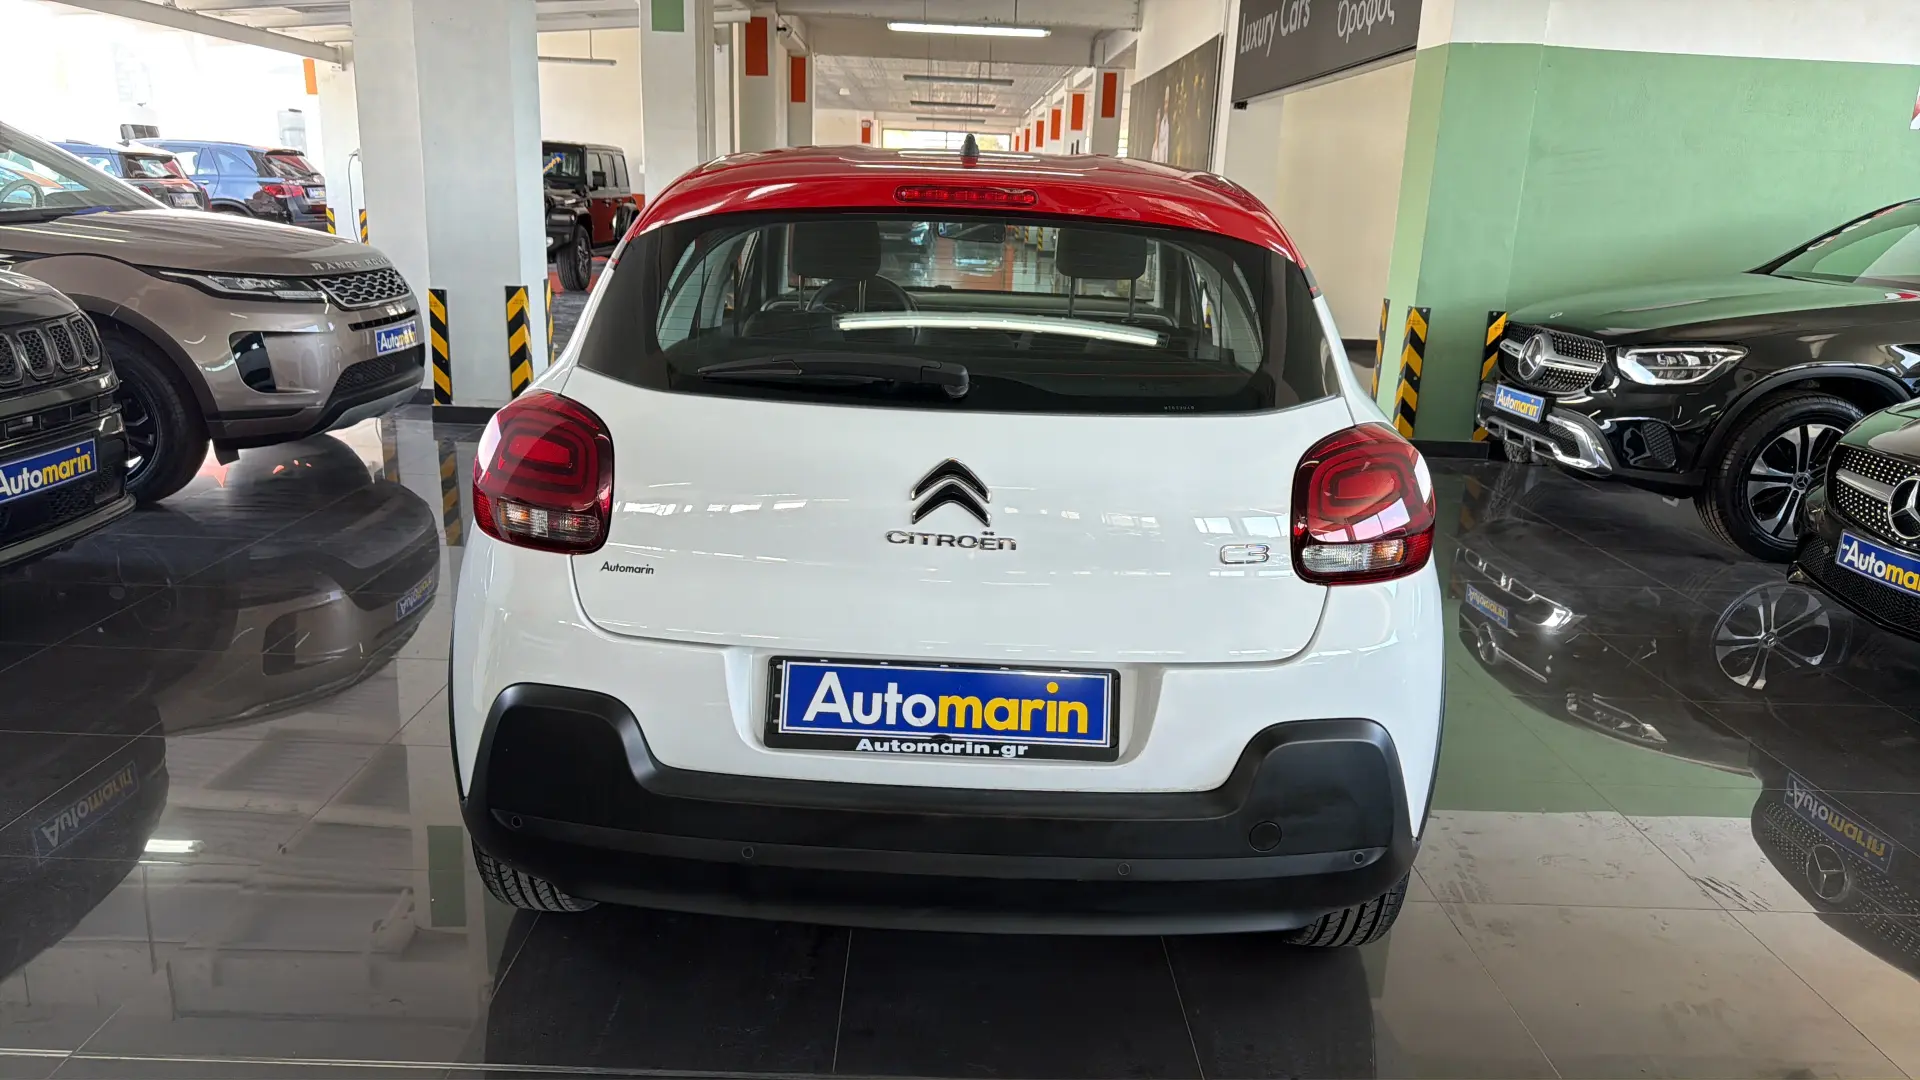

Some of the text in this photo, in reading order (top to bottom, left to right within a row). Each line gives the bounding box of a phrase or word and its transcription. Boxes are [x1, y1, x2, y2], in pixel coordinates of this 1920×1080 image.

[1240, 0, 1310, 57] Luxury Cars
[310, 260, 361, 271] RANGE
[1497, 389, 1538, 417] Automarin
[1219, 543, 1270, 565] C3
[1843, 540, 1920, 592] Automa
[601, 561, 655, 575] Automarin
[802, 671, 1089, 734] Automarin
[855, 738, 1028, 758] Automarin.gr
